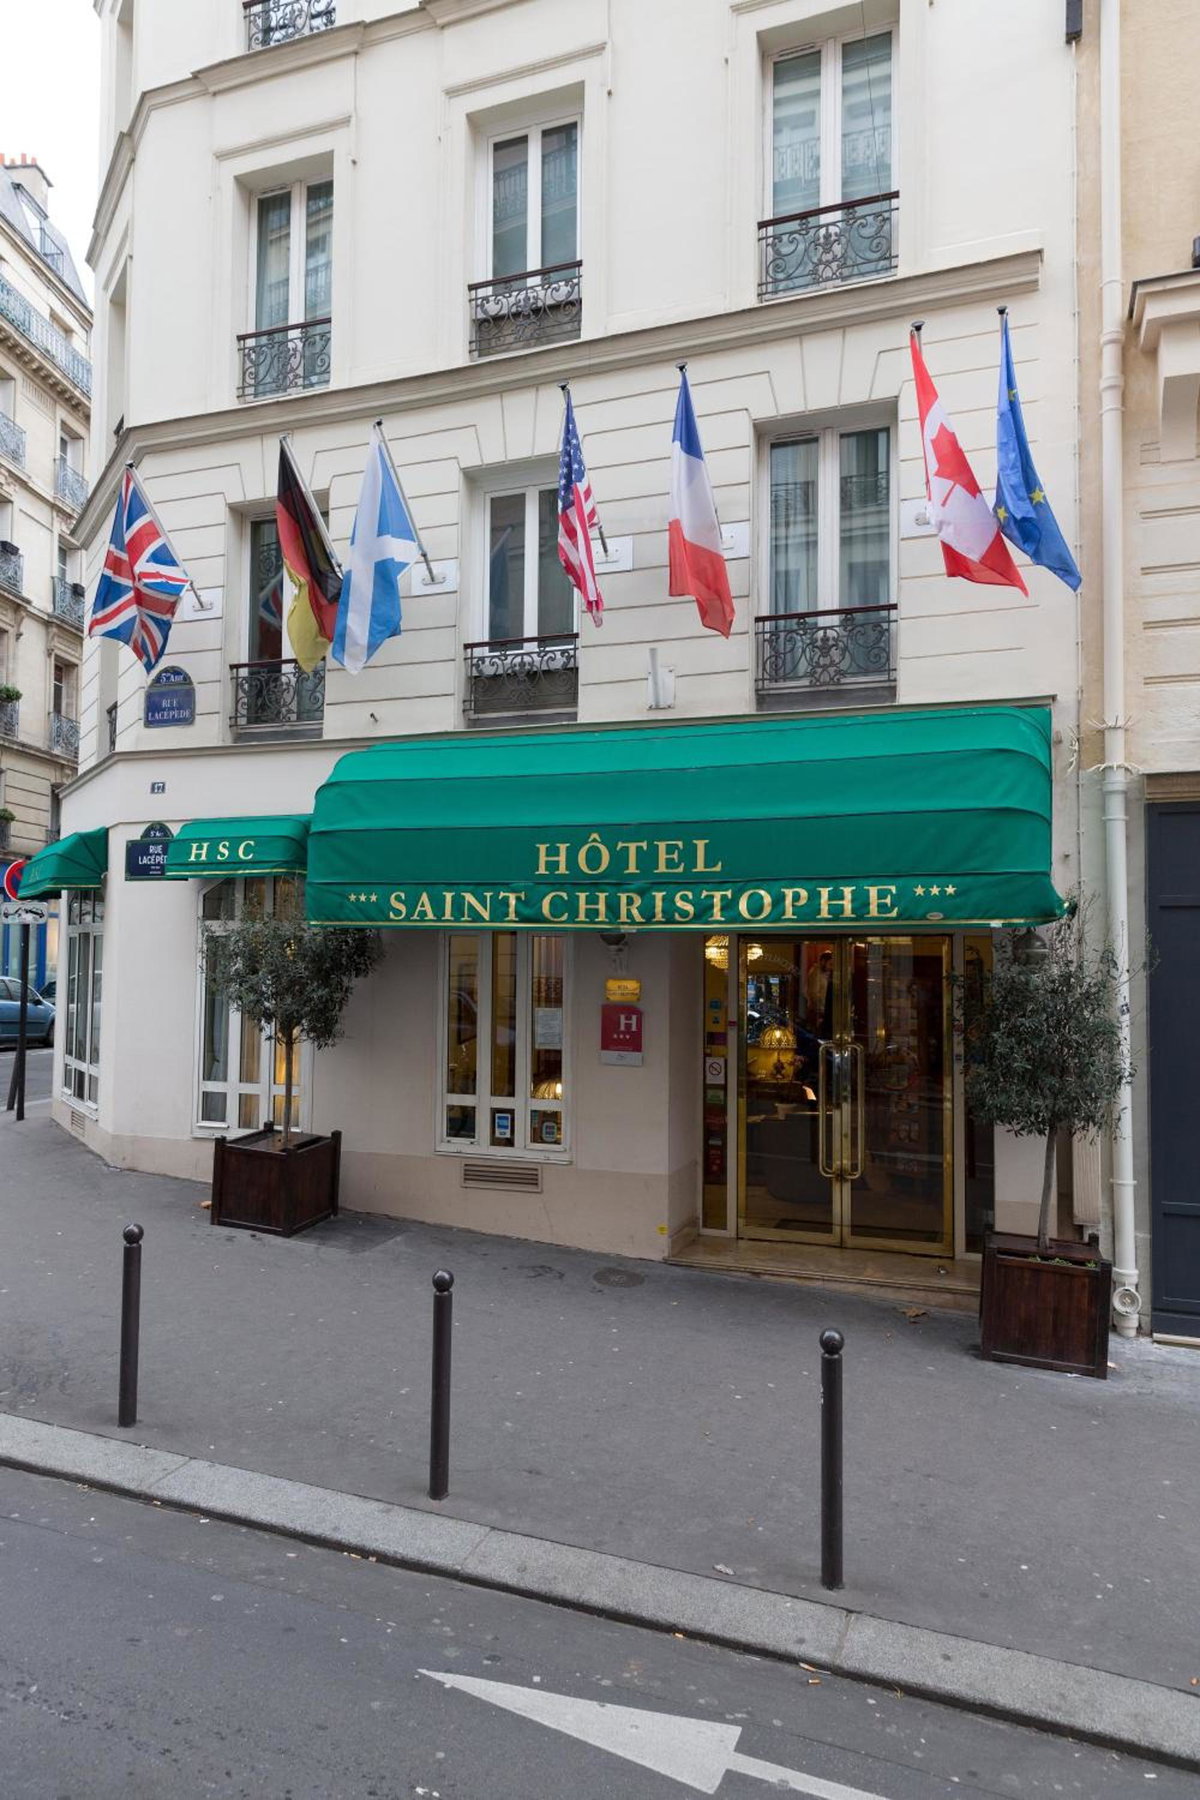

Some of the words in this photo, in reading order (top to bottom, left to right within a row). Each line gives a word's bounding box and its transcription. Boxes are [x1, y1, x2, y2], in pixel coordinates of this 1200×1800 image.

[162, 699, 178, 708] RUE
[149, 844, 163, 854] RUE
[534, 832, 722, 875] HÔTEL
[389, 891, 525, 921] SAINT
[541, 885, 899, 923] CHRISTOPHE
[619, 1014, 638, 1032] H
